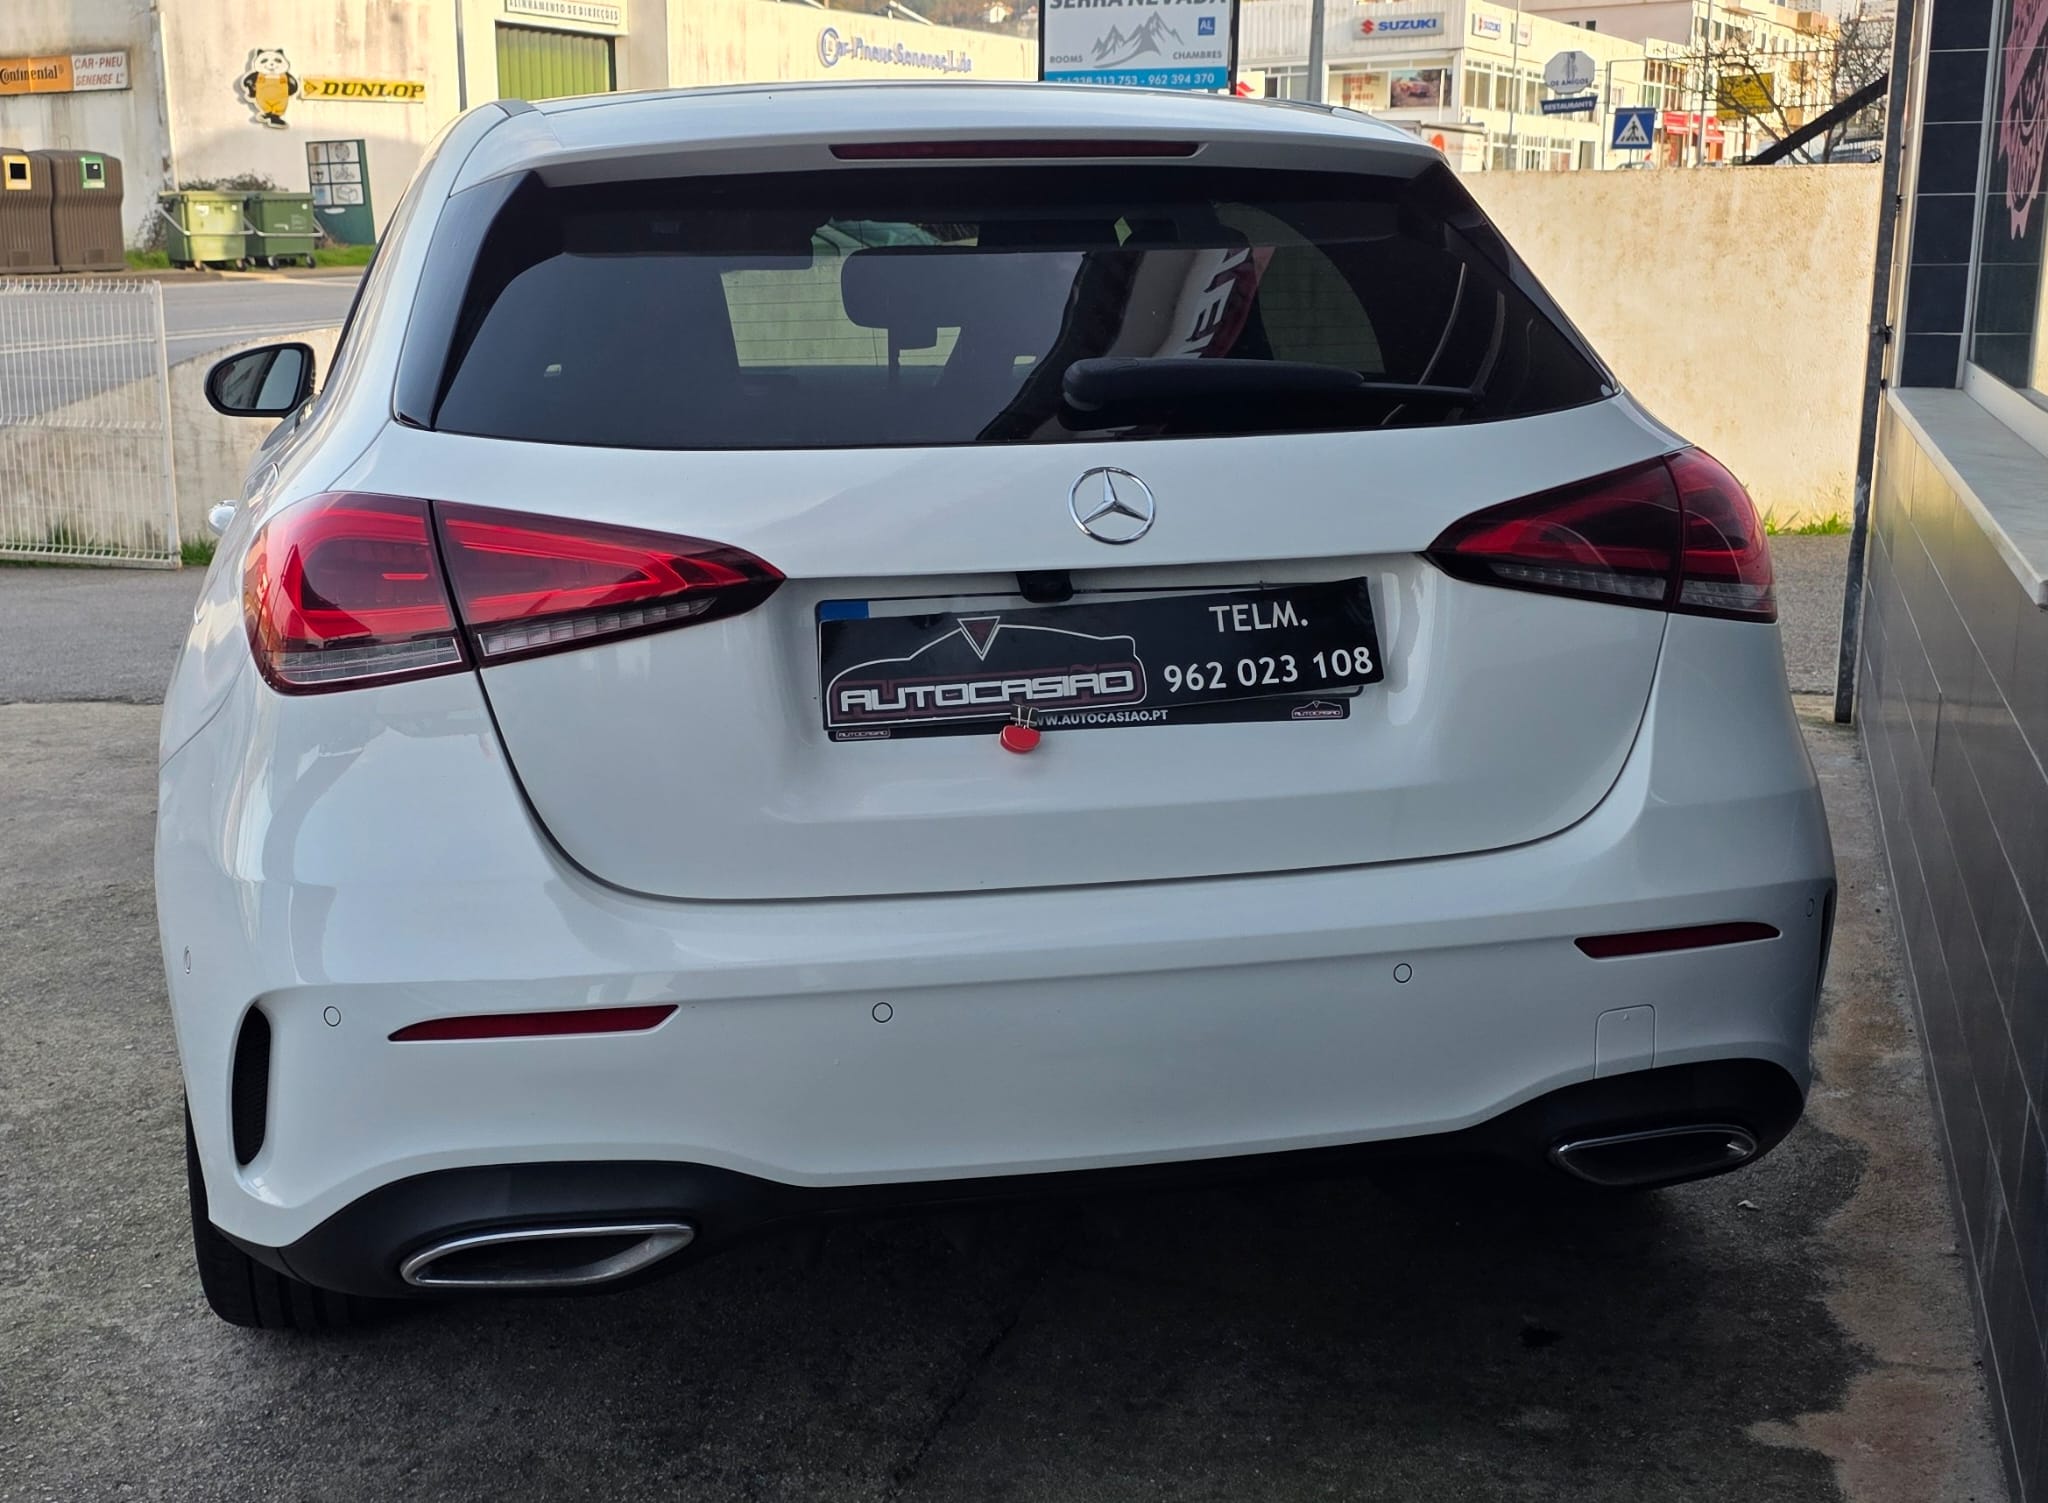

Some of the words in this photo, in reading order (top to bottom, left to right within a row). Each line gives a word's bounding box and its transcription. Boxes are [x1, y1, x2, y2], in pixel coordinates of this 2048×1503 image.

[1200, 20, 1214, 31] AL
[1378, 19, 1437, 31] SUZUKI
[1050, 55, 1083, 63] ROOMS
[1173, 51, 1222, 60] CHAMBRES
[0, 65, 58, 85] Continental
[1118, 76, 1138, 85] 753
[1148, 75, 1167, 85] 962
[1171, 75, 1191, 84] 394
[1194, 73, 1215, 84] 370
[321, 82, 424, 98] DUNLOP
[1543, 100, 1593, 111] RESTAURANTE
[1208, 600, 1309, 632] TELM.
[1164, 661, 1227, 693] 962
[1237, 655, 1298, 686] 023
[1312, 646, 1373, 679] 108
